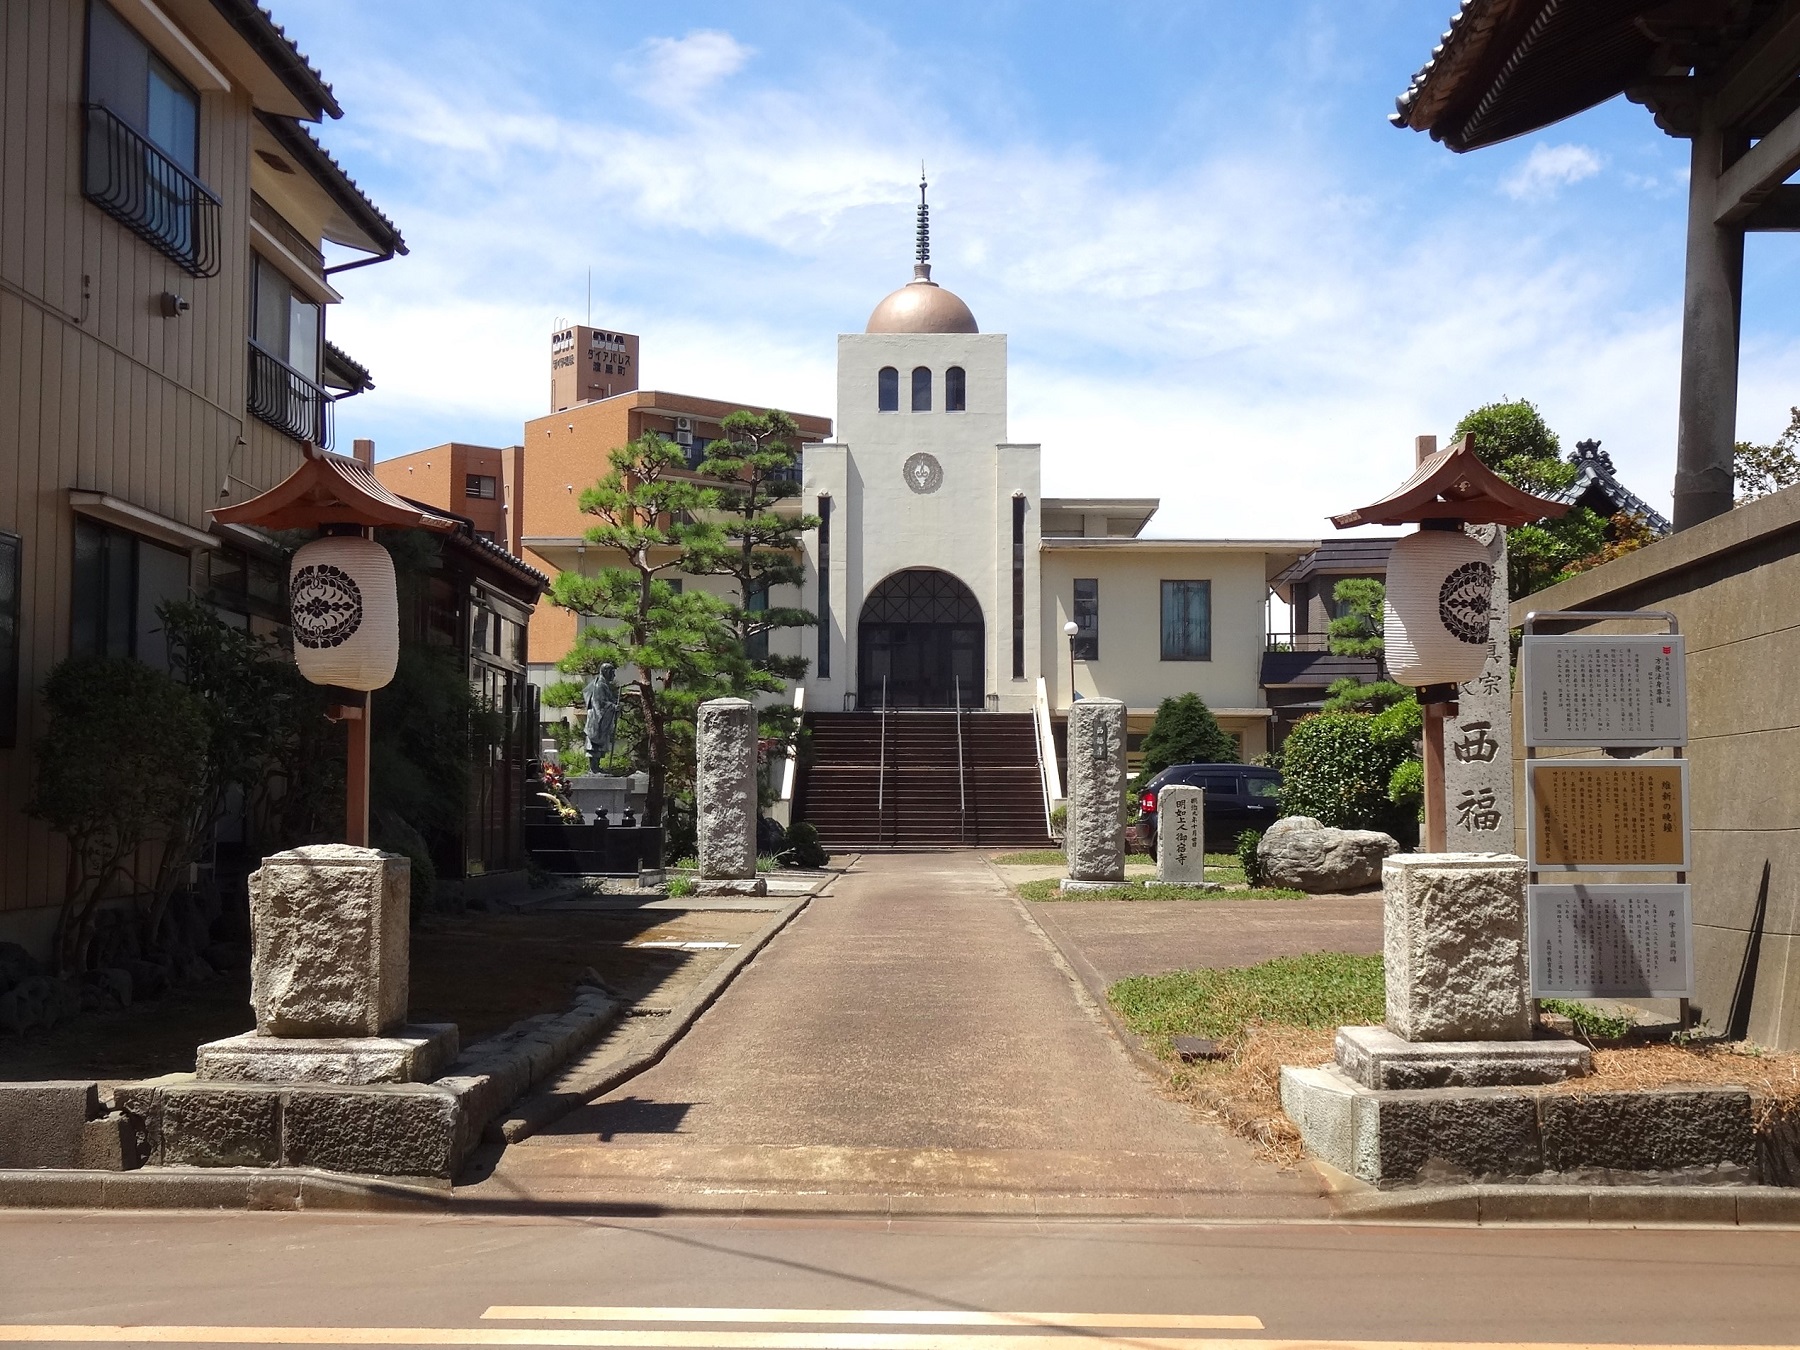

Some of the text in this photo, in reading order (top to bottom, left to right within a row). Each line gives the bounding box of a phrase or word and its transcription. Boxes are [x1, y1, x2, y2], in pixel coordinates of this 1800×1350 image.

[592, 330, 626, 352] DIA
[588, 349, 631, 366] ダイアパレス
